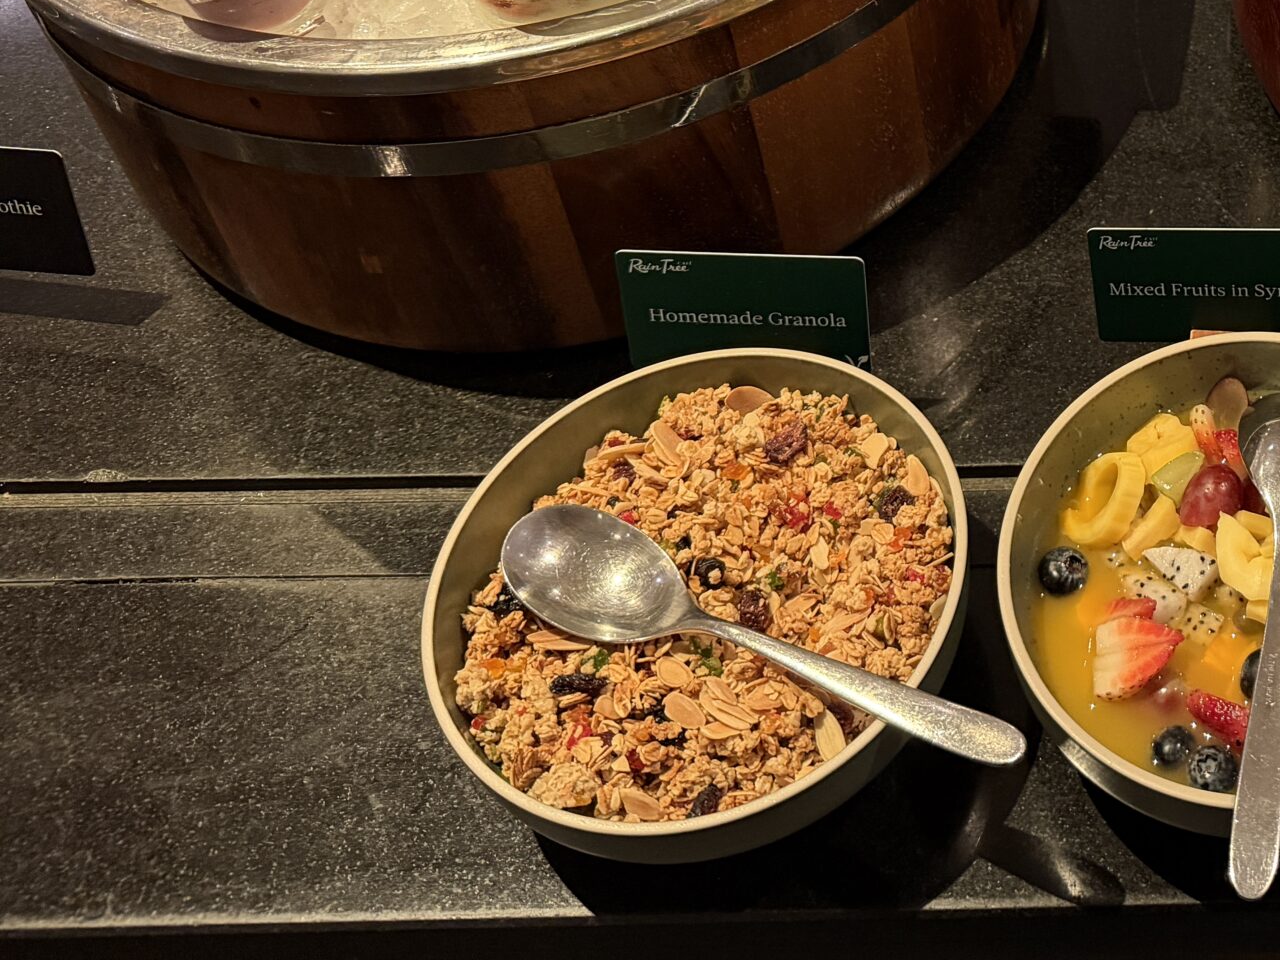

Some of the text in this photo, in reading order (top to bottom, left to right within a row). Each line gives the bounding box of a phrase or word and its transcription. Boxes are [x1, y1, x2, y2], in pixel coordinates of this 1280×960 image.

[1109, 282, 1167, 297] Mixed
[1172, 282, 1227, 298] Fruits
[1231, 283, 1250, 298] in
[648, 308, 848, 328] Homemade Granola
